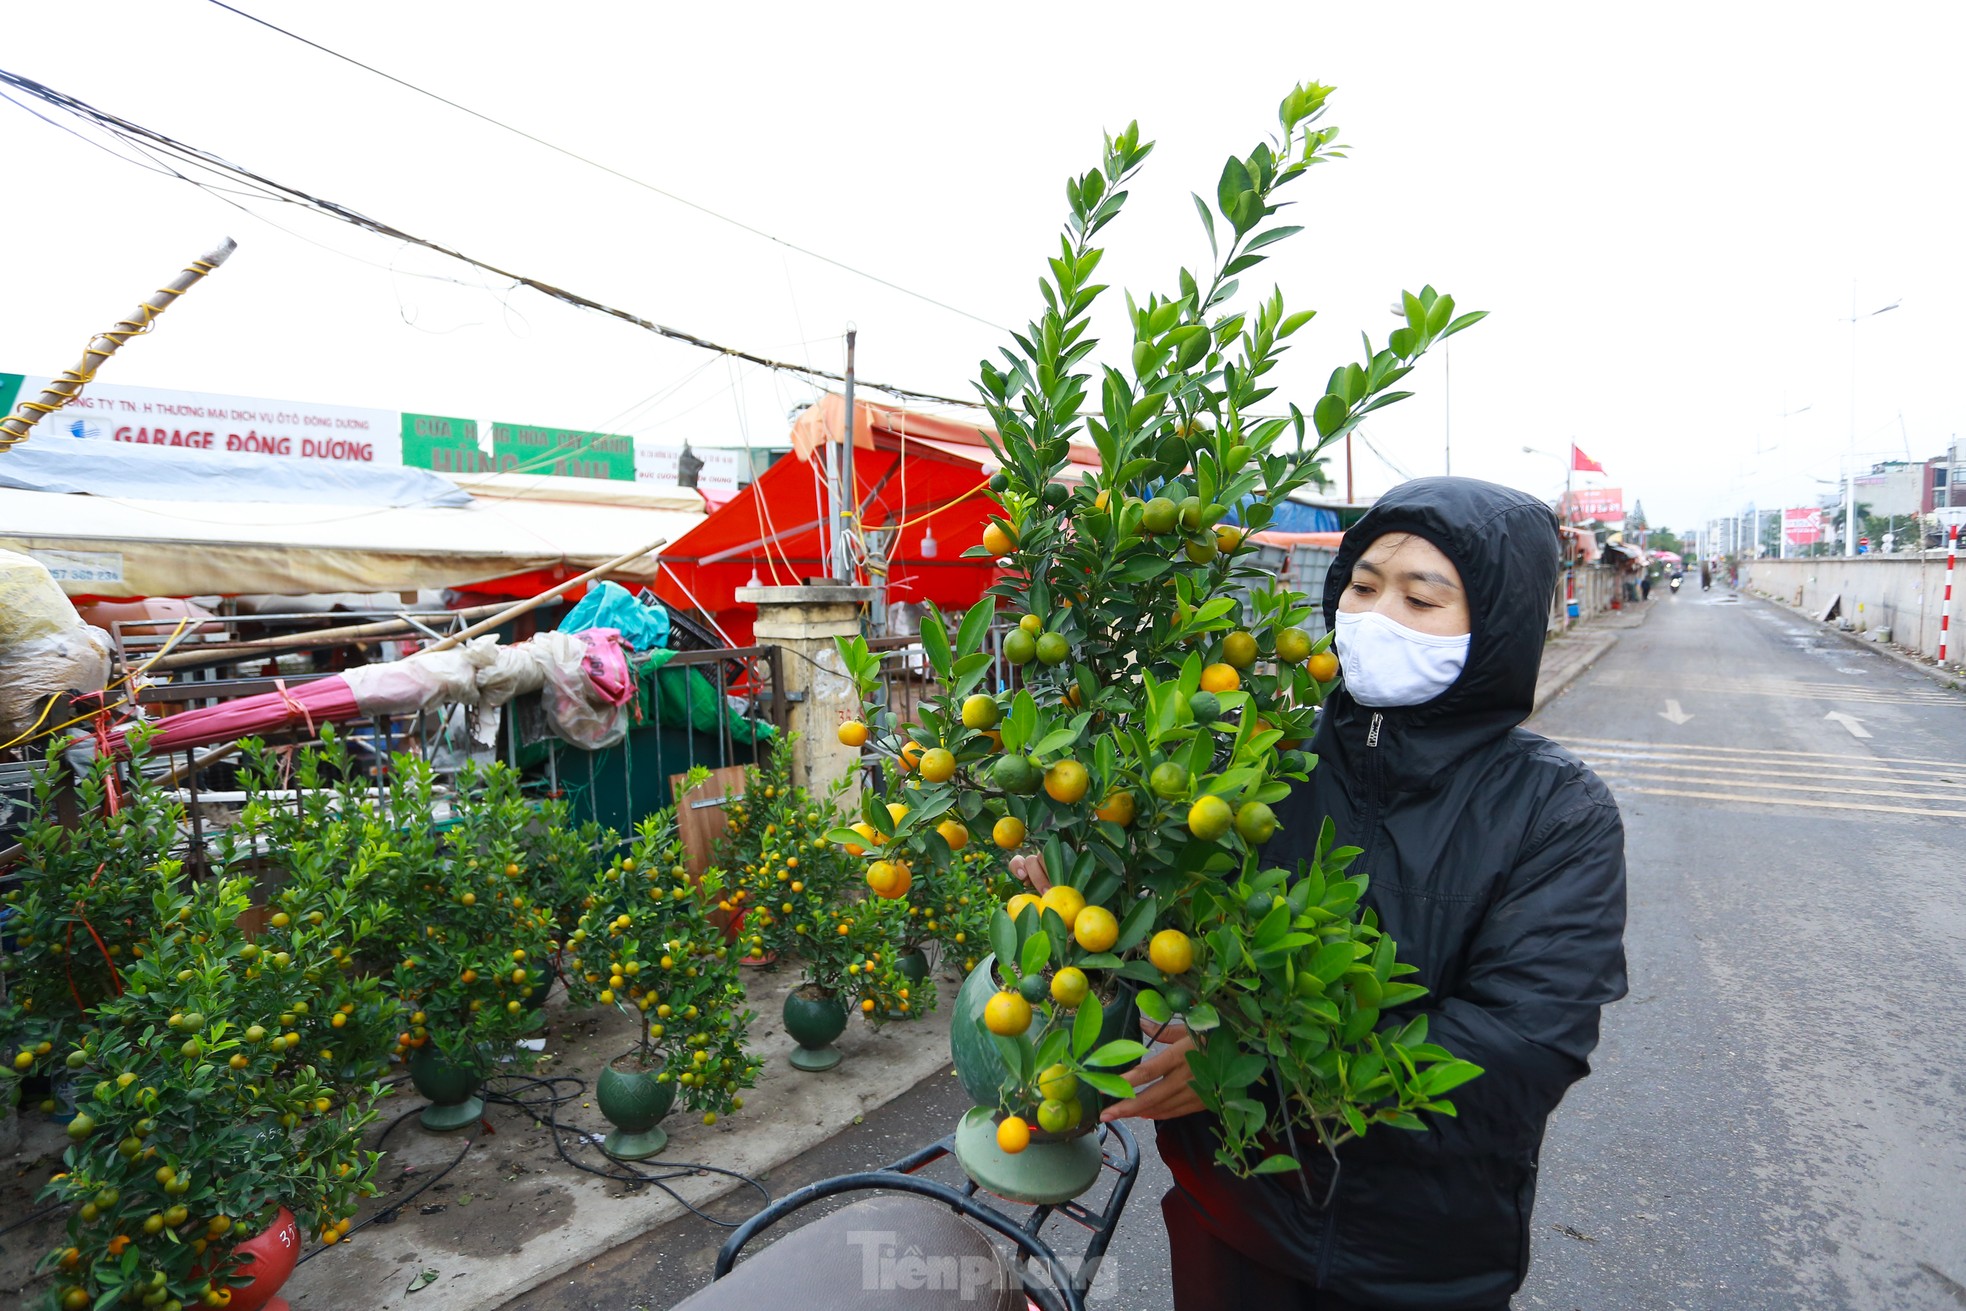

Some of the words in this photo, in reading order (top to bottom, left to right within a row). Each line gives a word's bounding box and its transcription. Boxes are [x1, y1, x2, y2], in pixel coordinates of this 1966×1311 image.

[97, 398, 114, 410] TY
[276, 411, 300, 425] ÔTÔ
[114, 426, 214, 450] GARAGE
[225, 430, 292, 455] ĐÔNG
[301, 437, 374, 462] DƯƠNG
[518, 429, 549, 448] HOA
